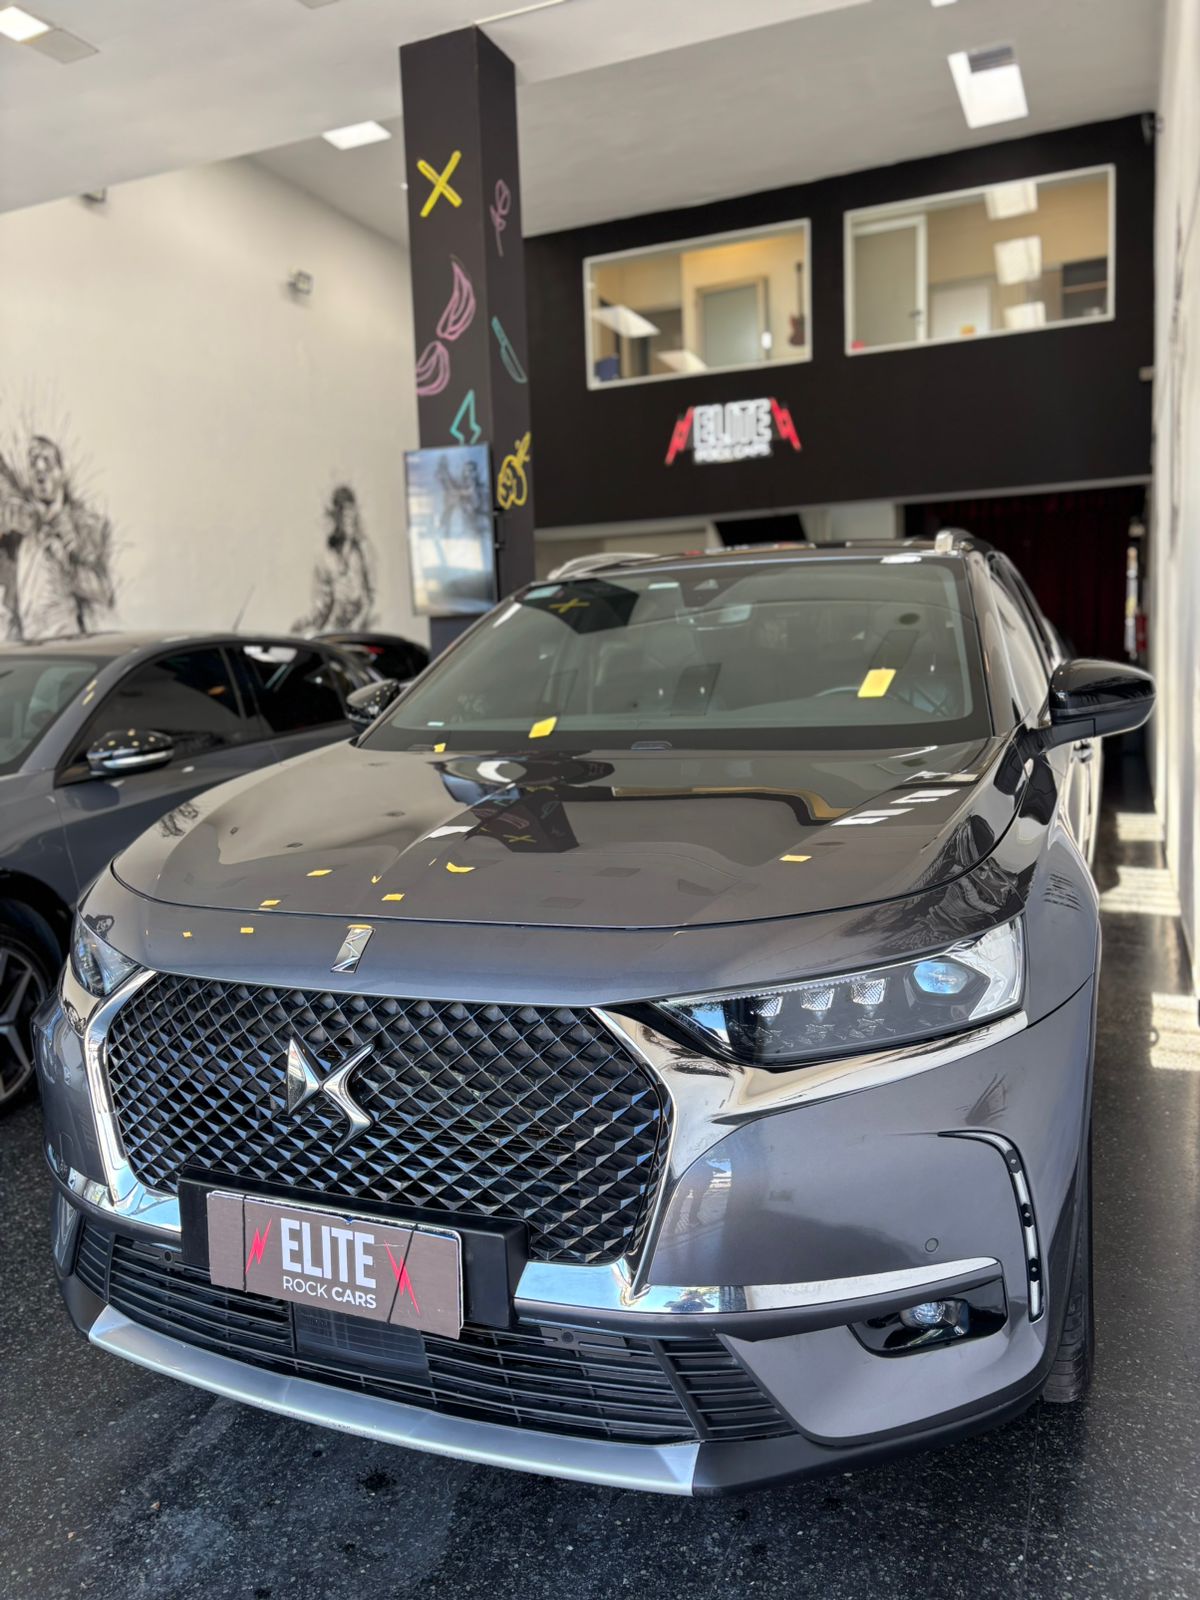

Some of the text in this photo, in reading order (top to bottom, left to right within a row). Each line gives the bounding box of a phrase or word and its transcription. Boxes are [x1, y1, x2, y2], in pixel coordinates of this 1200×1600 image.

[693, 398, 771, 448] ELITE
[281, 1217, 376, 1289] ELITE
[283, 1275, 377, 1309] ROCK CARS
